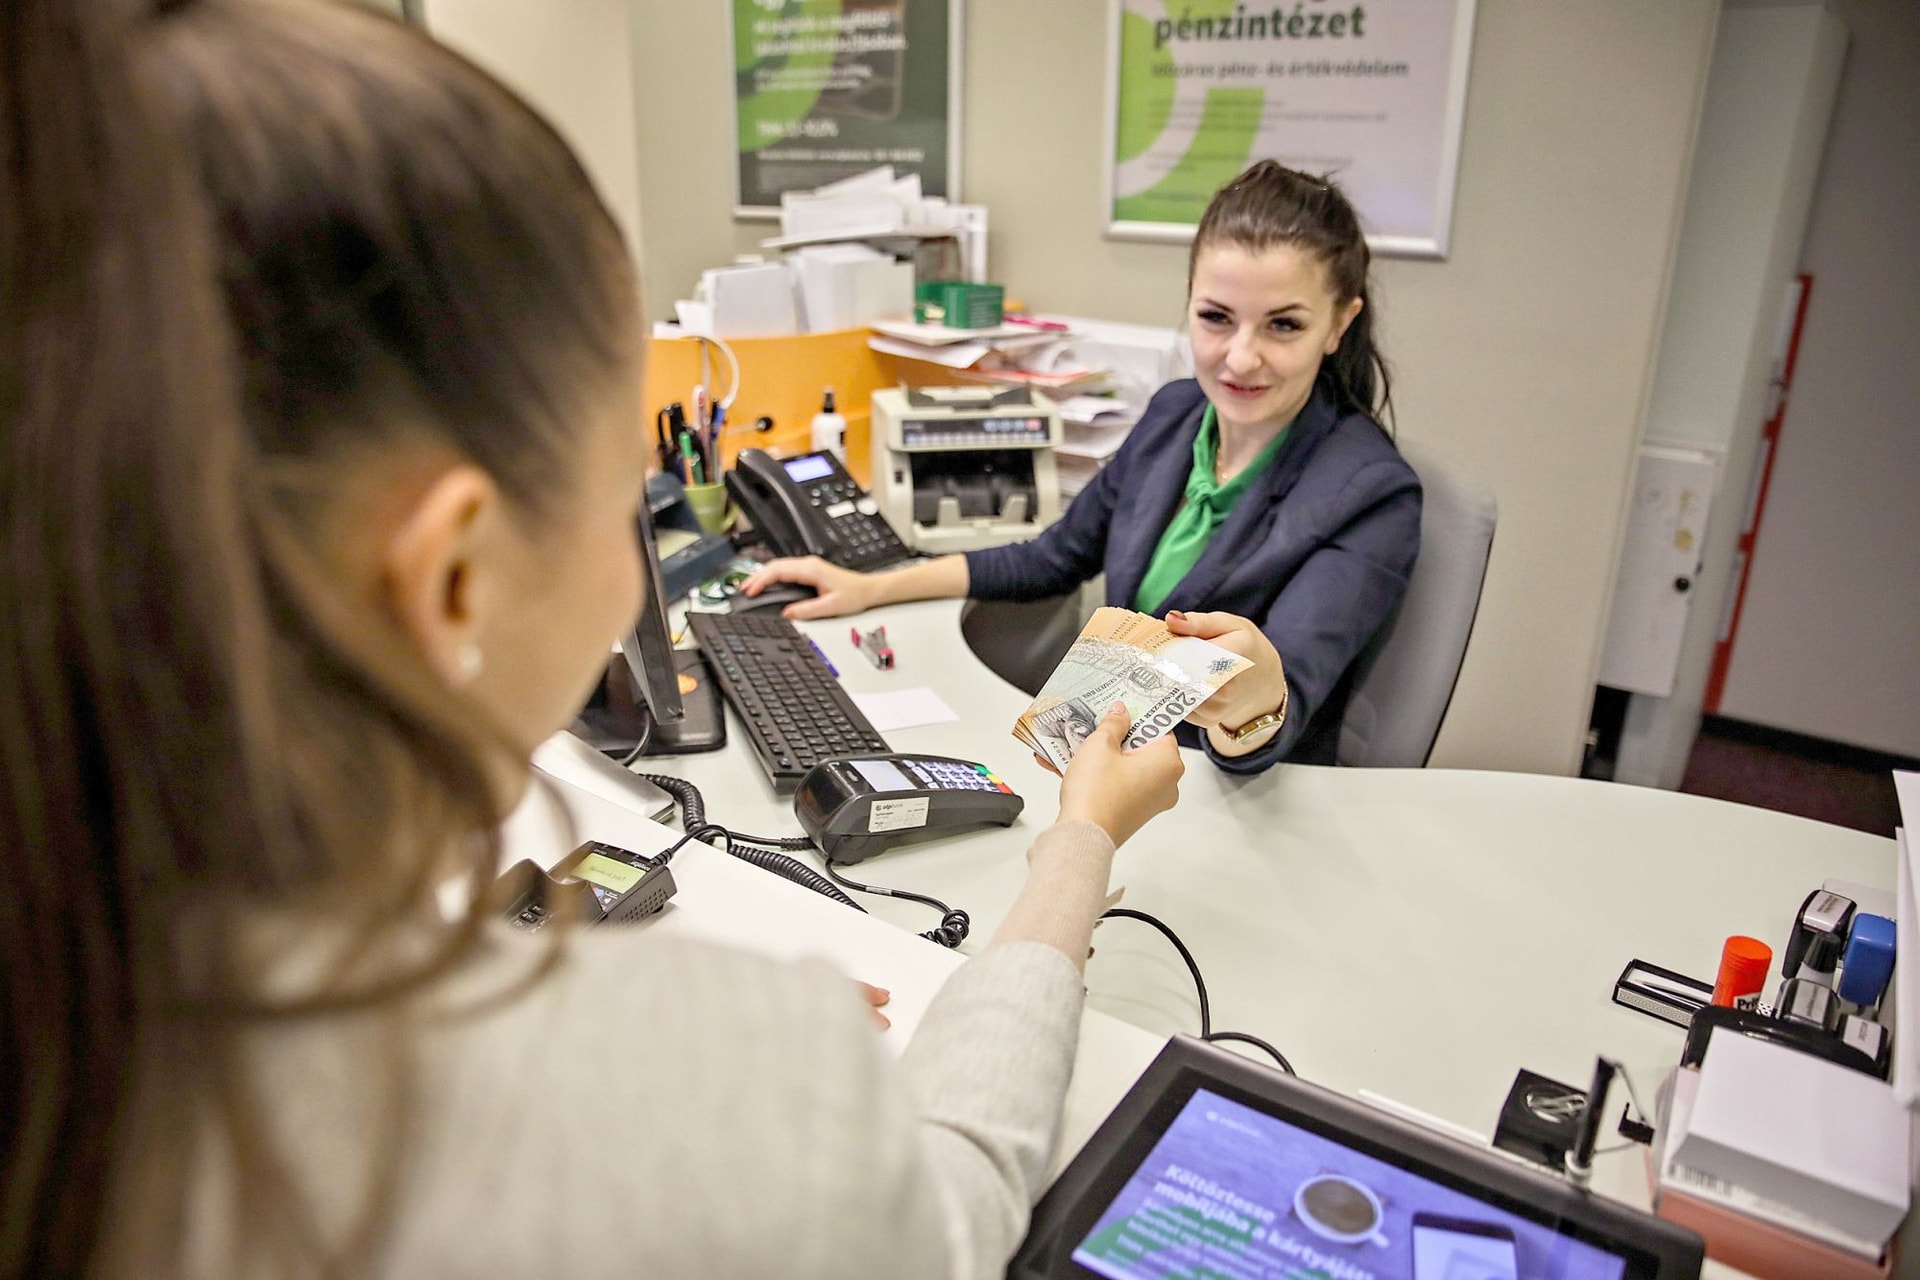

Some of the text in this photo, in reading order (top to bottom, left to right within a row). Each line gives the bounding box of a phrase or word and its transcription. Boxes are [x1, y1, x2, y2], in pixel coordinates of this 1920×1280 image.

[1155, 4, 1365, 49] pénzintézet
[1031, 703, 1073, 729] 20000
[1130, 691, 1196, 749] 20000
[1123, 718, 1145, 742] FORI
[1252, 1226, 1267, 1242] a
